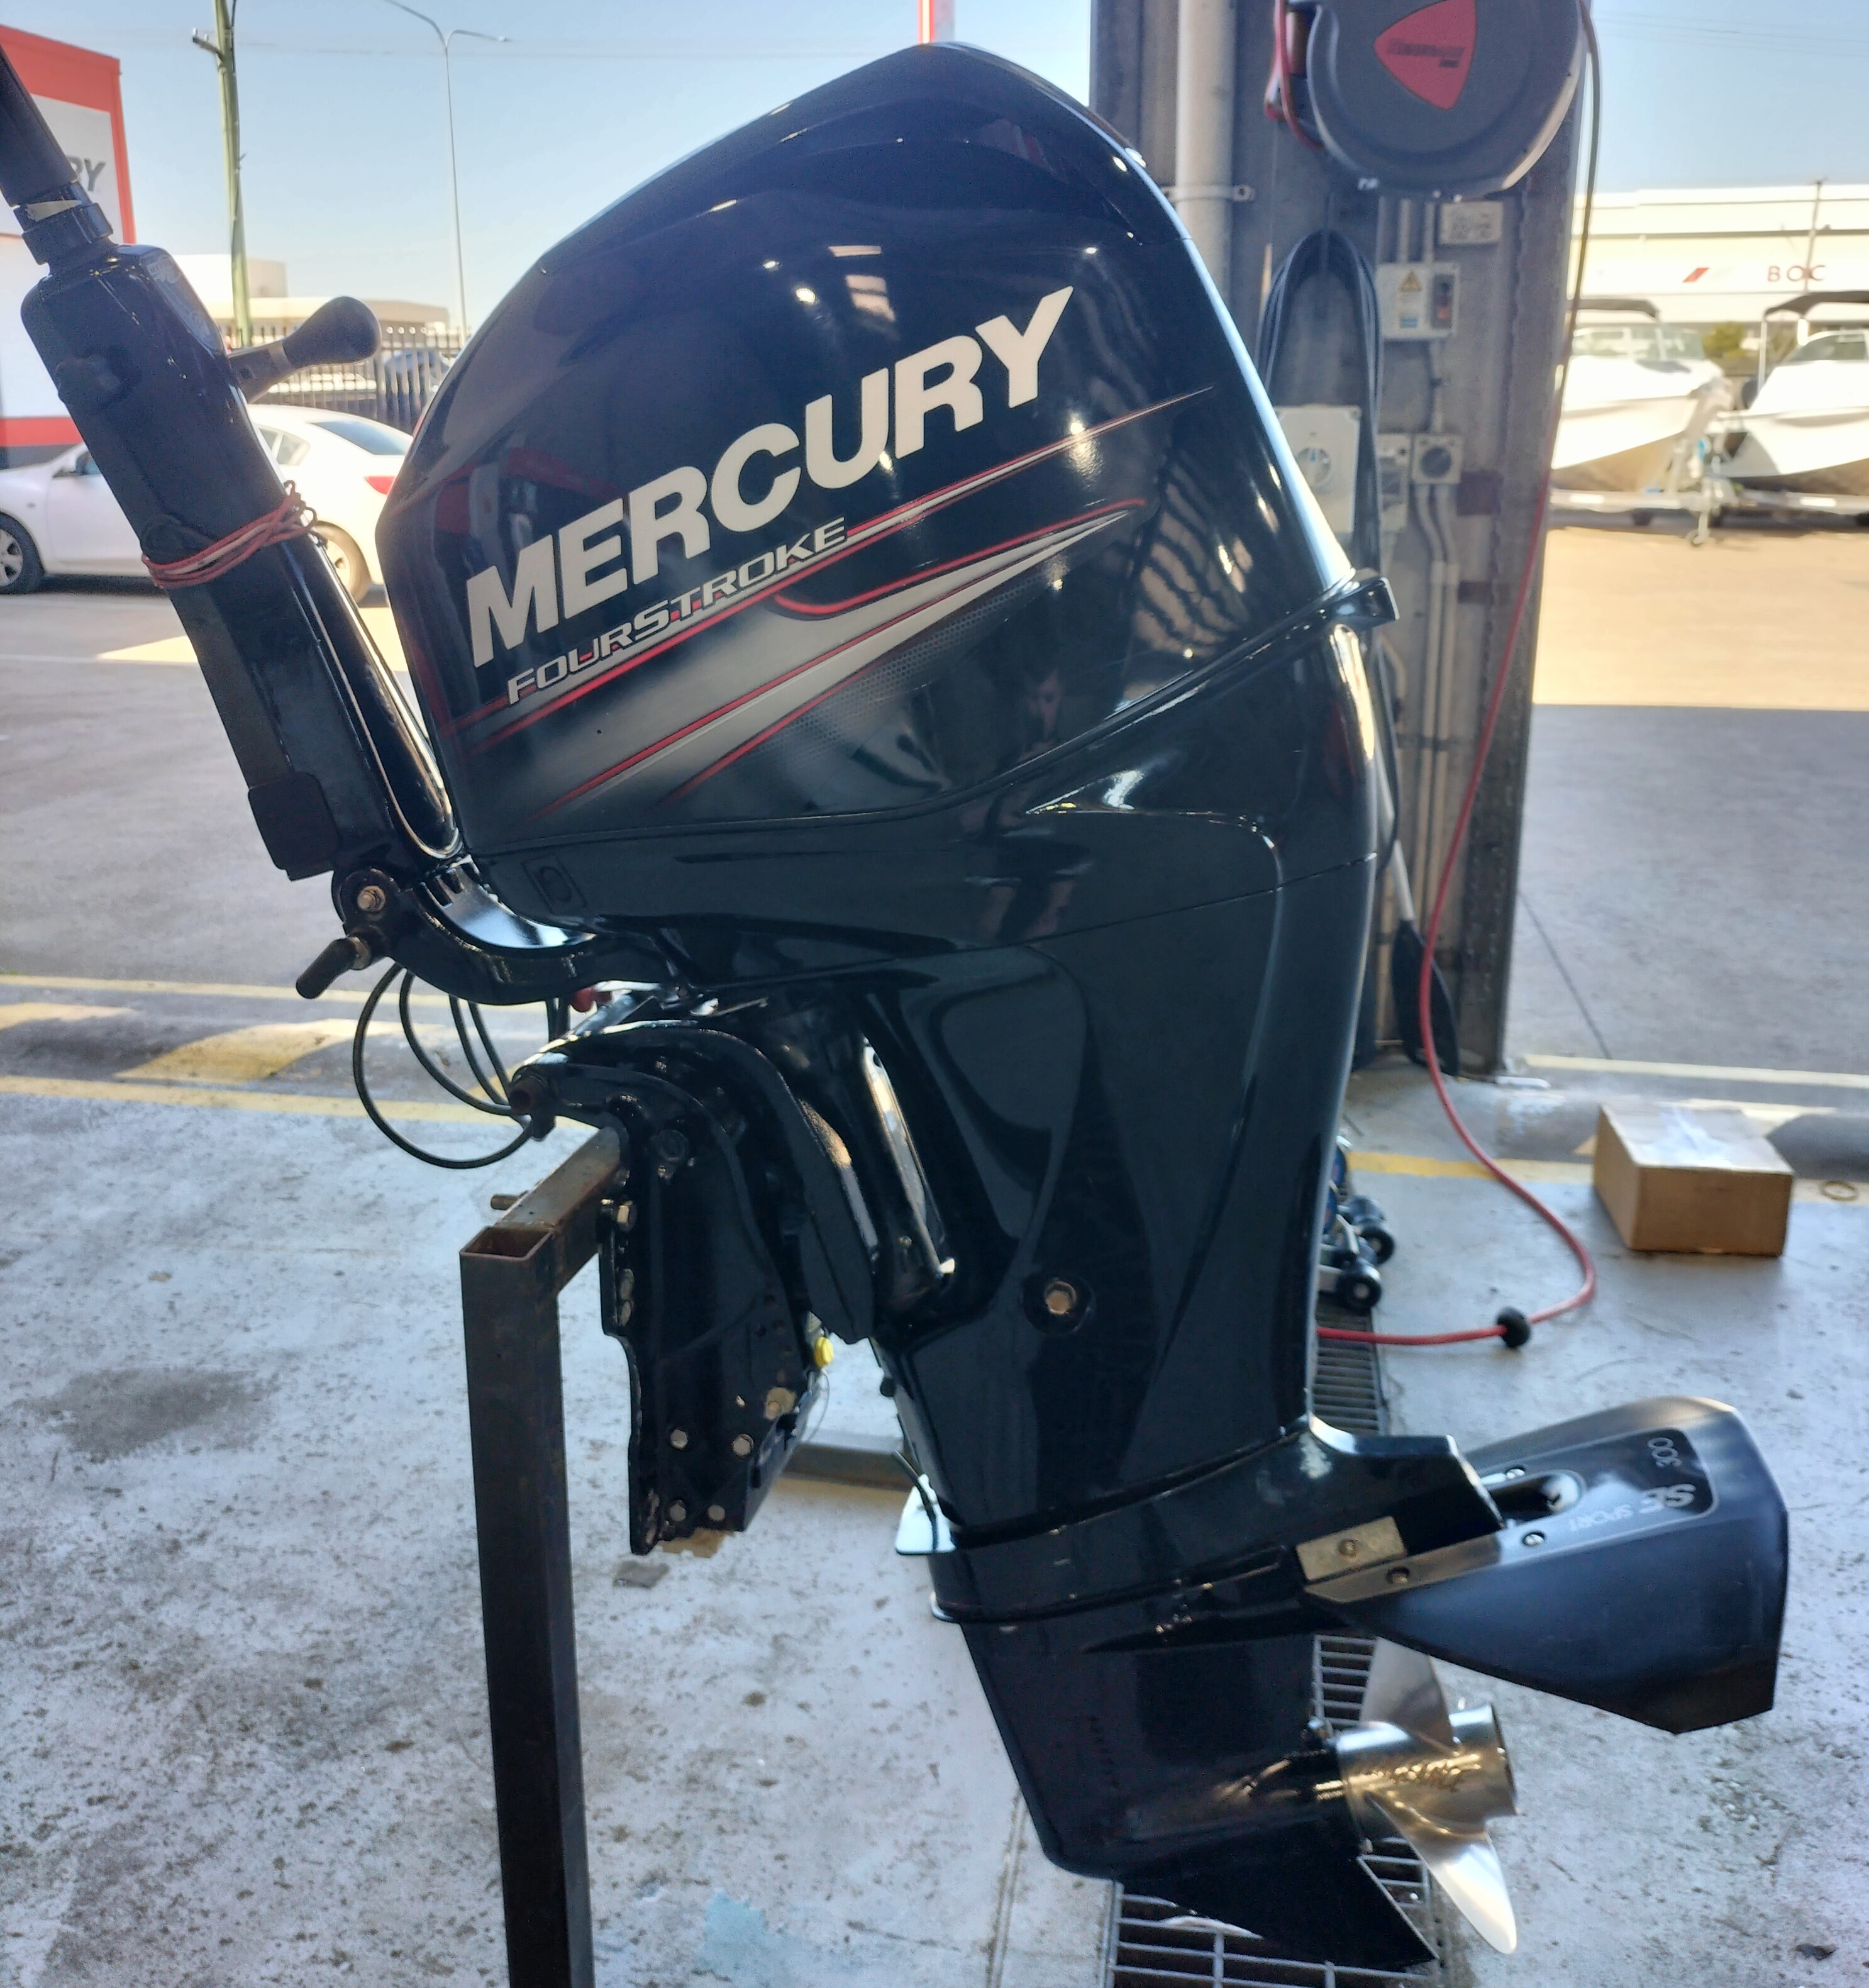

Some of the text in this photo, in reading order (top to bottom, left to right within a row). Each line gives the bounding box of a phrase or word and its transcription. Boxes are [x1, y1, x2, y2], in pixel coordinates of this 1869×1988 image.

[1767, 264, 1826, 282] BOC
[465, 286, 1073, 668] MERCURY
[507, 516, 848, 704] FOURSTROKE
[1647, 1437, 1682, 1469] 300
